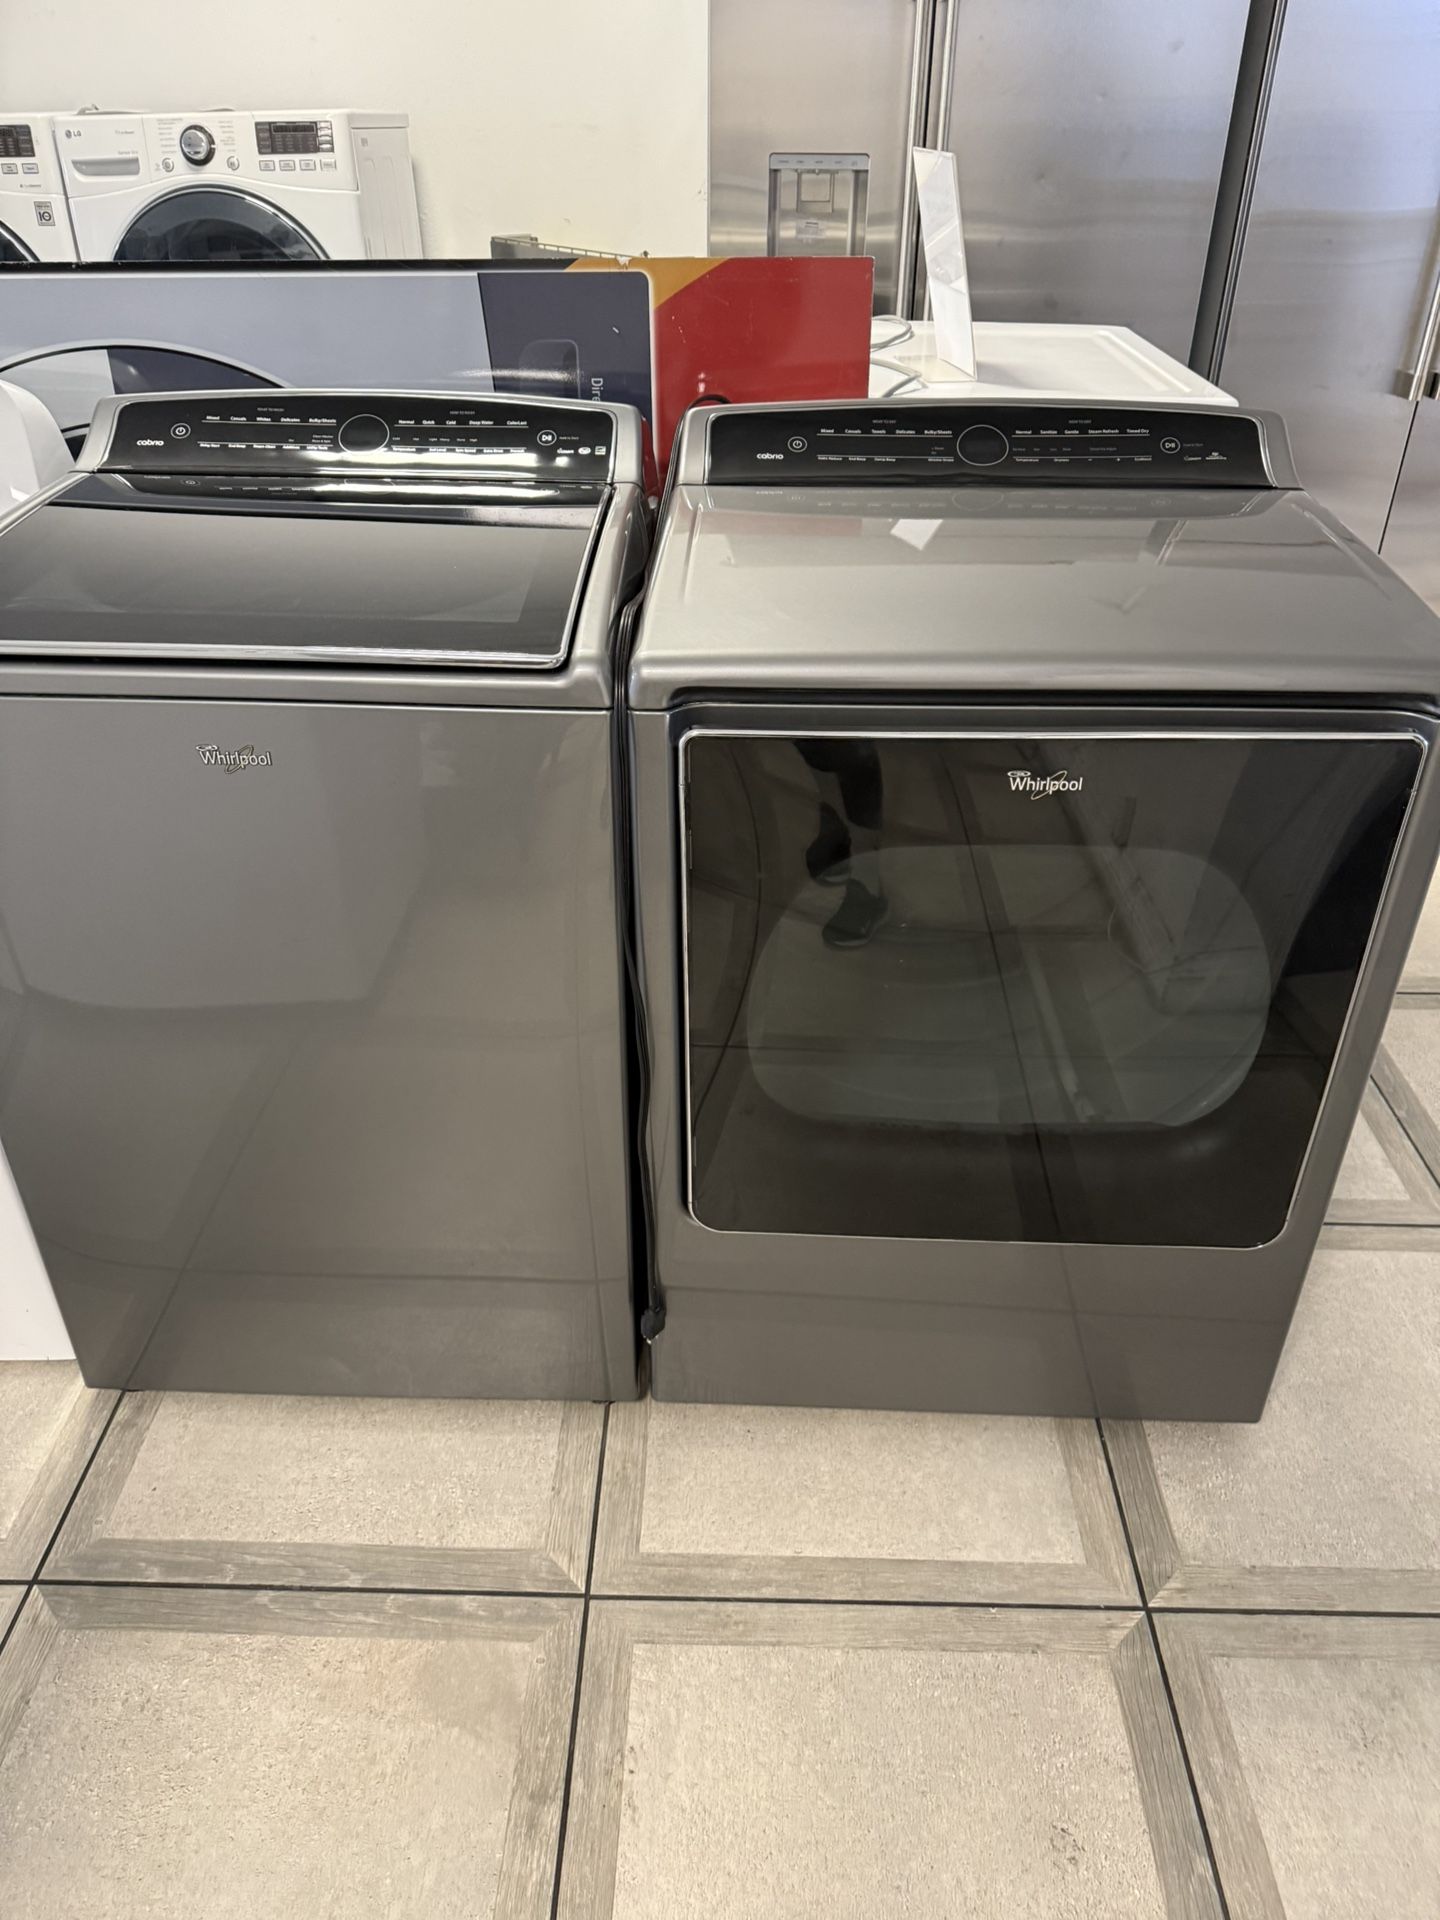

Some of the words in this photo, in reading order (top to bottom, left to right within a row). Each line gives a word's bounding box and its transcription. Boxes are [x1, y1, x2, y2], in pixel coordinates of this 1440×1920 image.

[756, 452, 784, 460] cabrio
[197, 747, 273, 770] Whirlpool
[1007, 774, 1083, 797] Whirlpool
